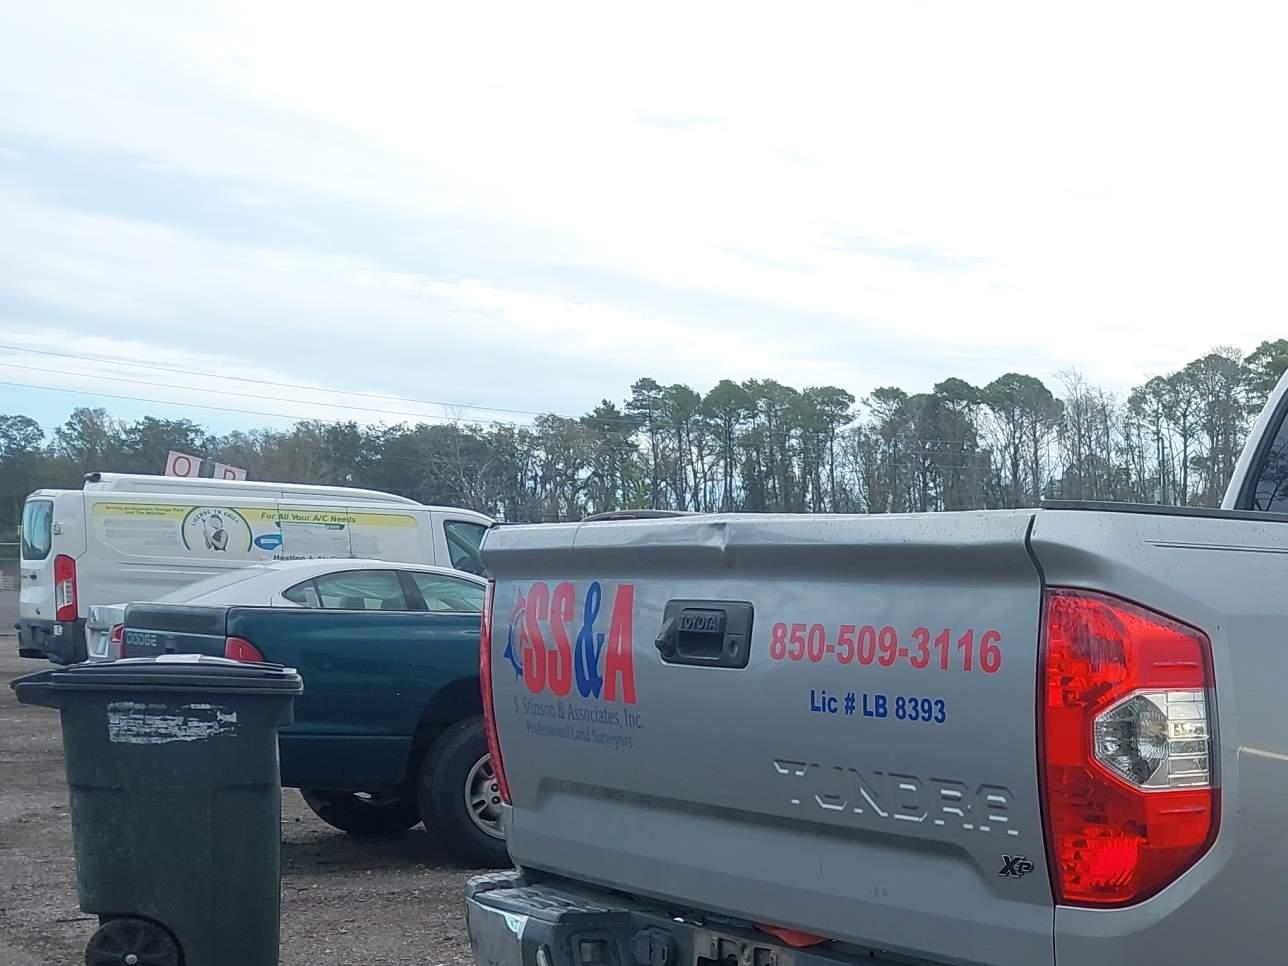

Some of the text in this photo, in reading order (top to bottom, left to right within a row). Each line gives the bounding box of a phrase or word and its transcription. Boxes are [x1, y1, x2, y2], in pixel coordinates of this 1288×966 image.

[279, 513, 290, 521] All
[312, 514, 328, 522] A/C
[330, 515, 356, 523] Needs
[680, 614, 717, 631] TOYOTA
[127, 632, 157, 647] DODGE
[769, 622, 1003, 674] 850-509-3116
[810, 690, 946, 724] Lic # LB 8393
[773, 759, 1019, 835] TUNDRA
